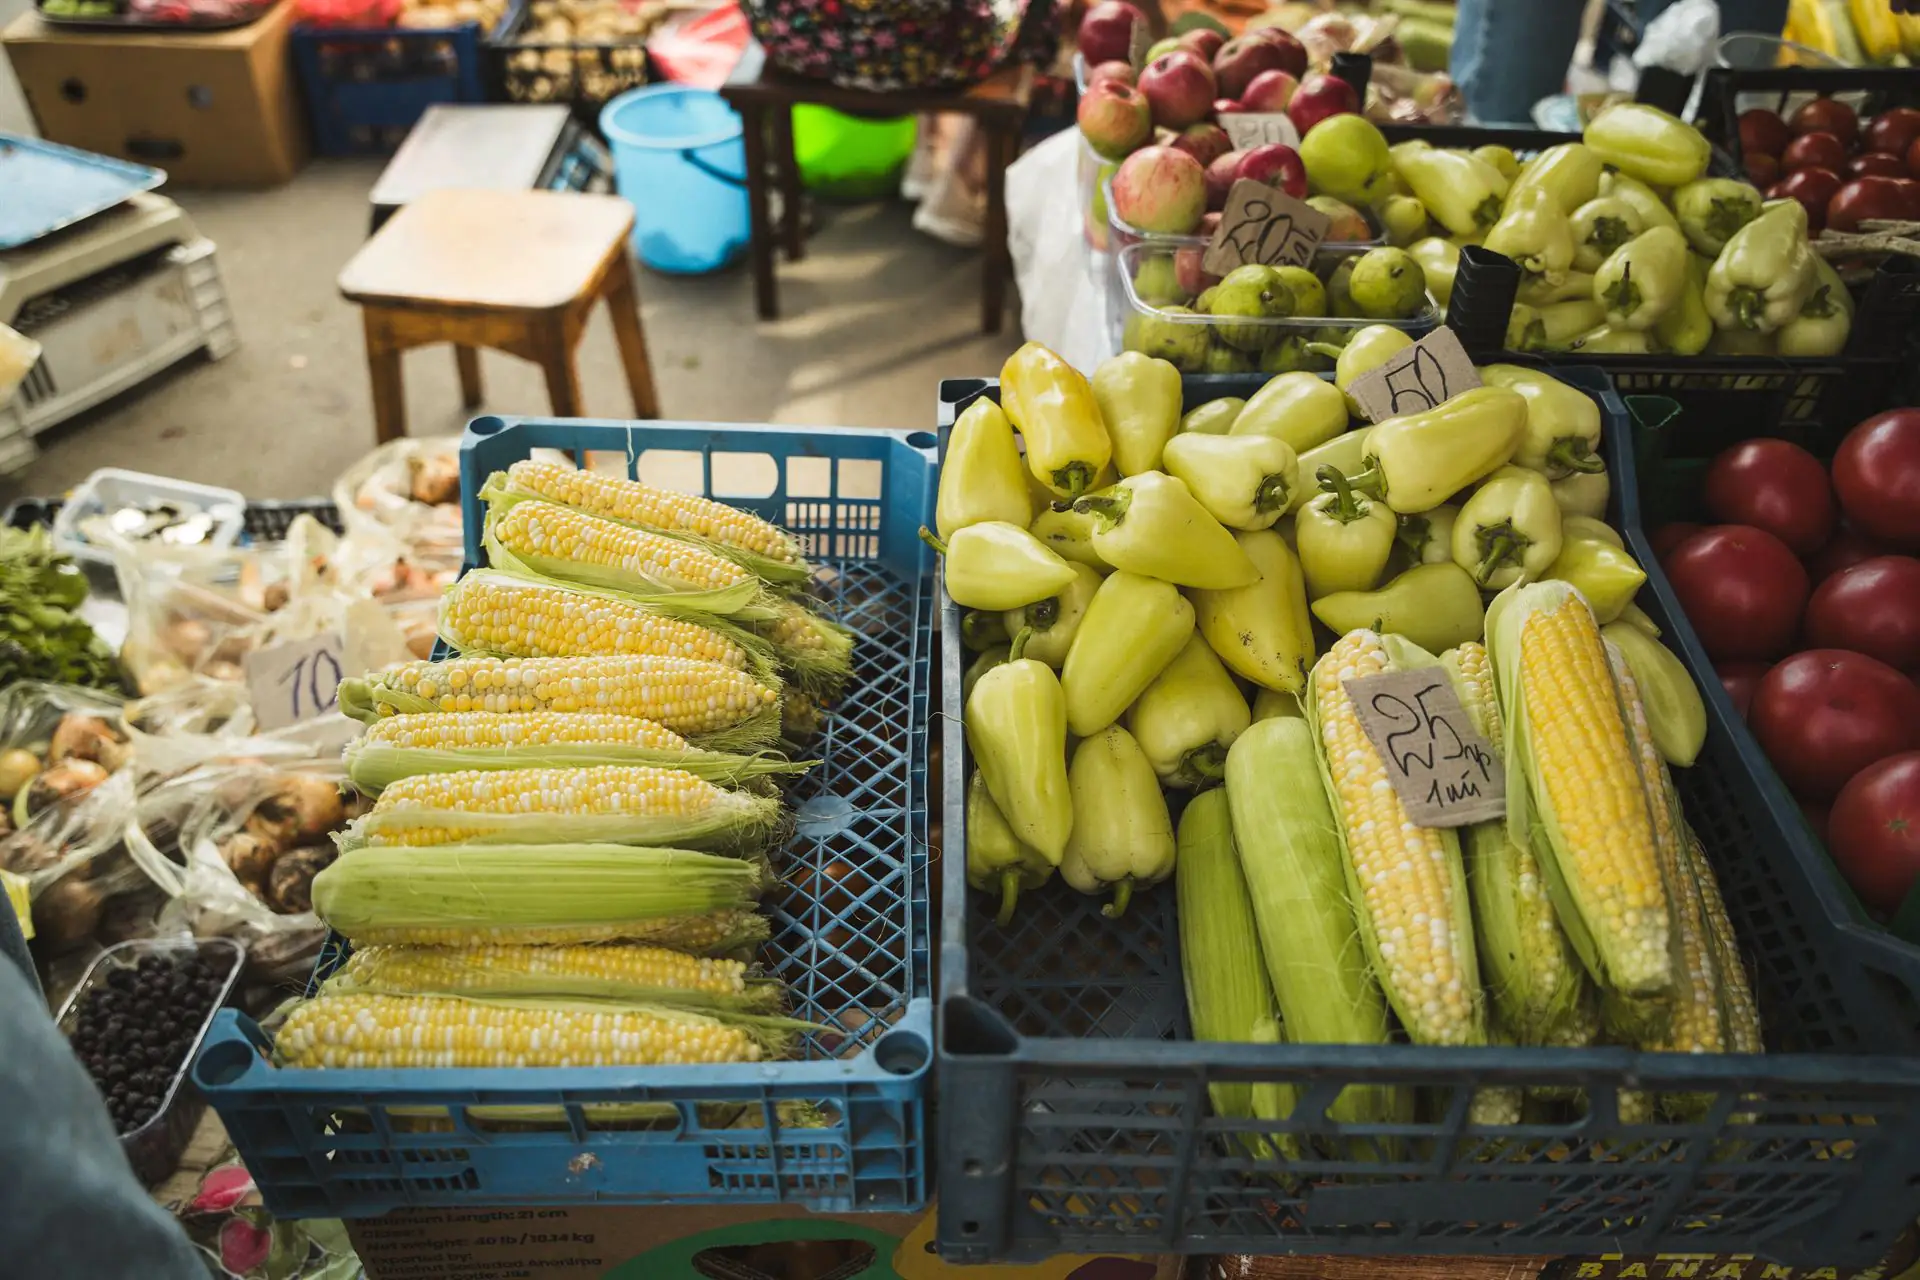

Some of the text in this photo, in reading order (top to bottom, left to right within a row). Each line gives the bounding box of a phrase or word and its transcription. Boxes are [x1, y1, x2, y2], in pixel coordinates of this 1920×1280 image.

[1384, 345, 1449, 414] 50
[277, 648, 343, 718] 10
[537, 1209, 569, 1219] cm
[571, 1232, 596, 1245] kg
